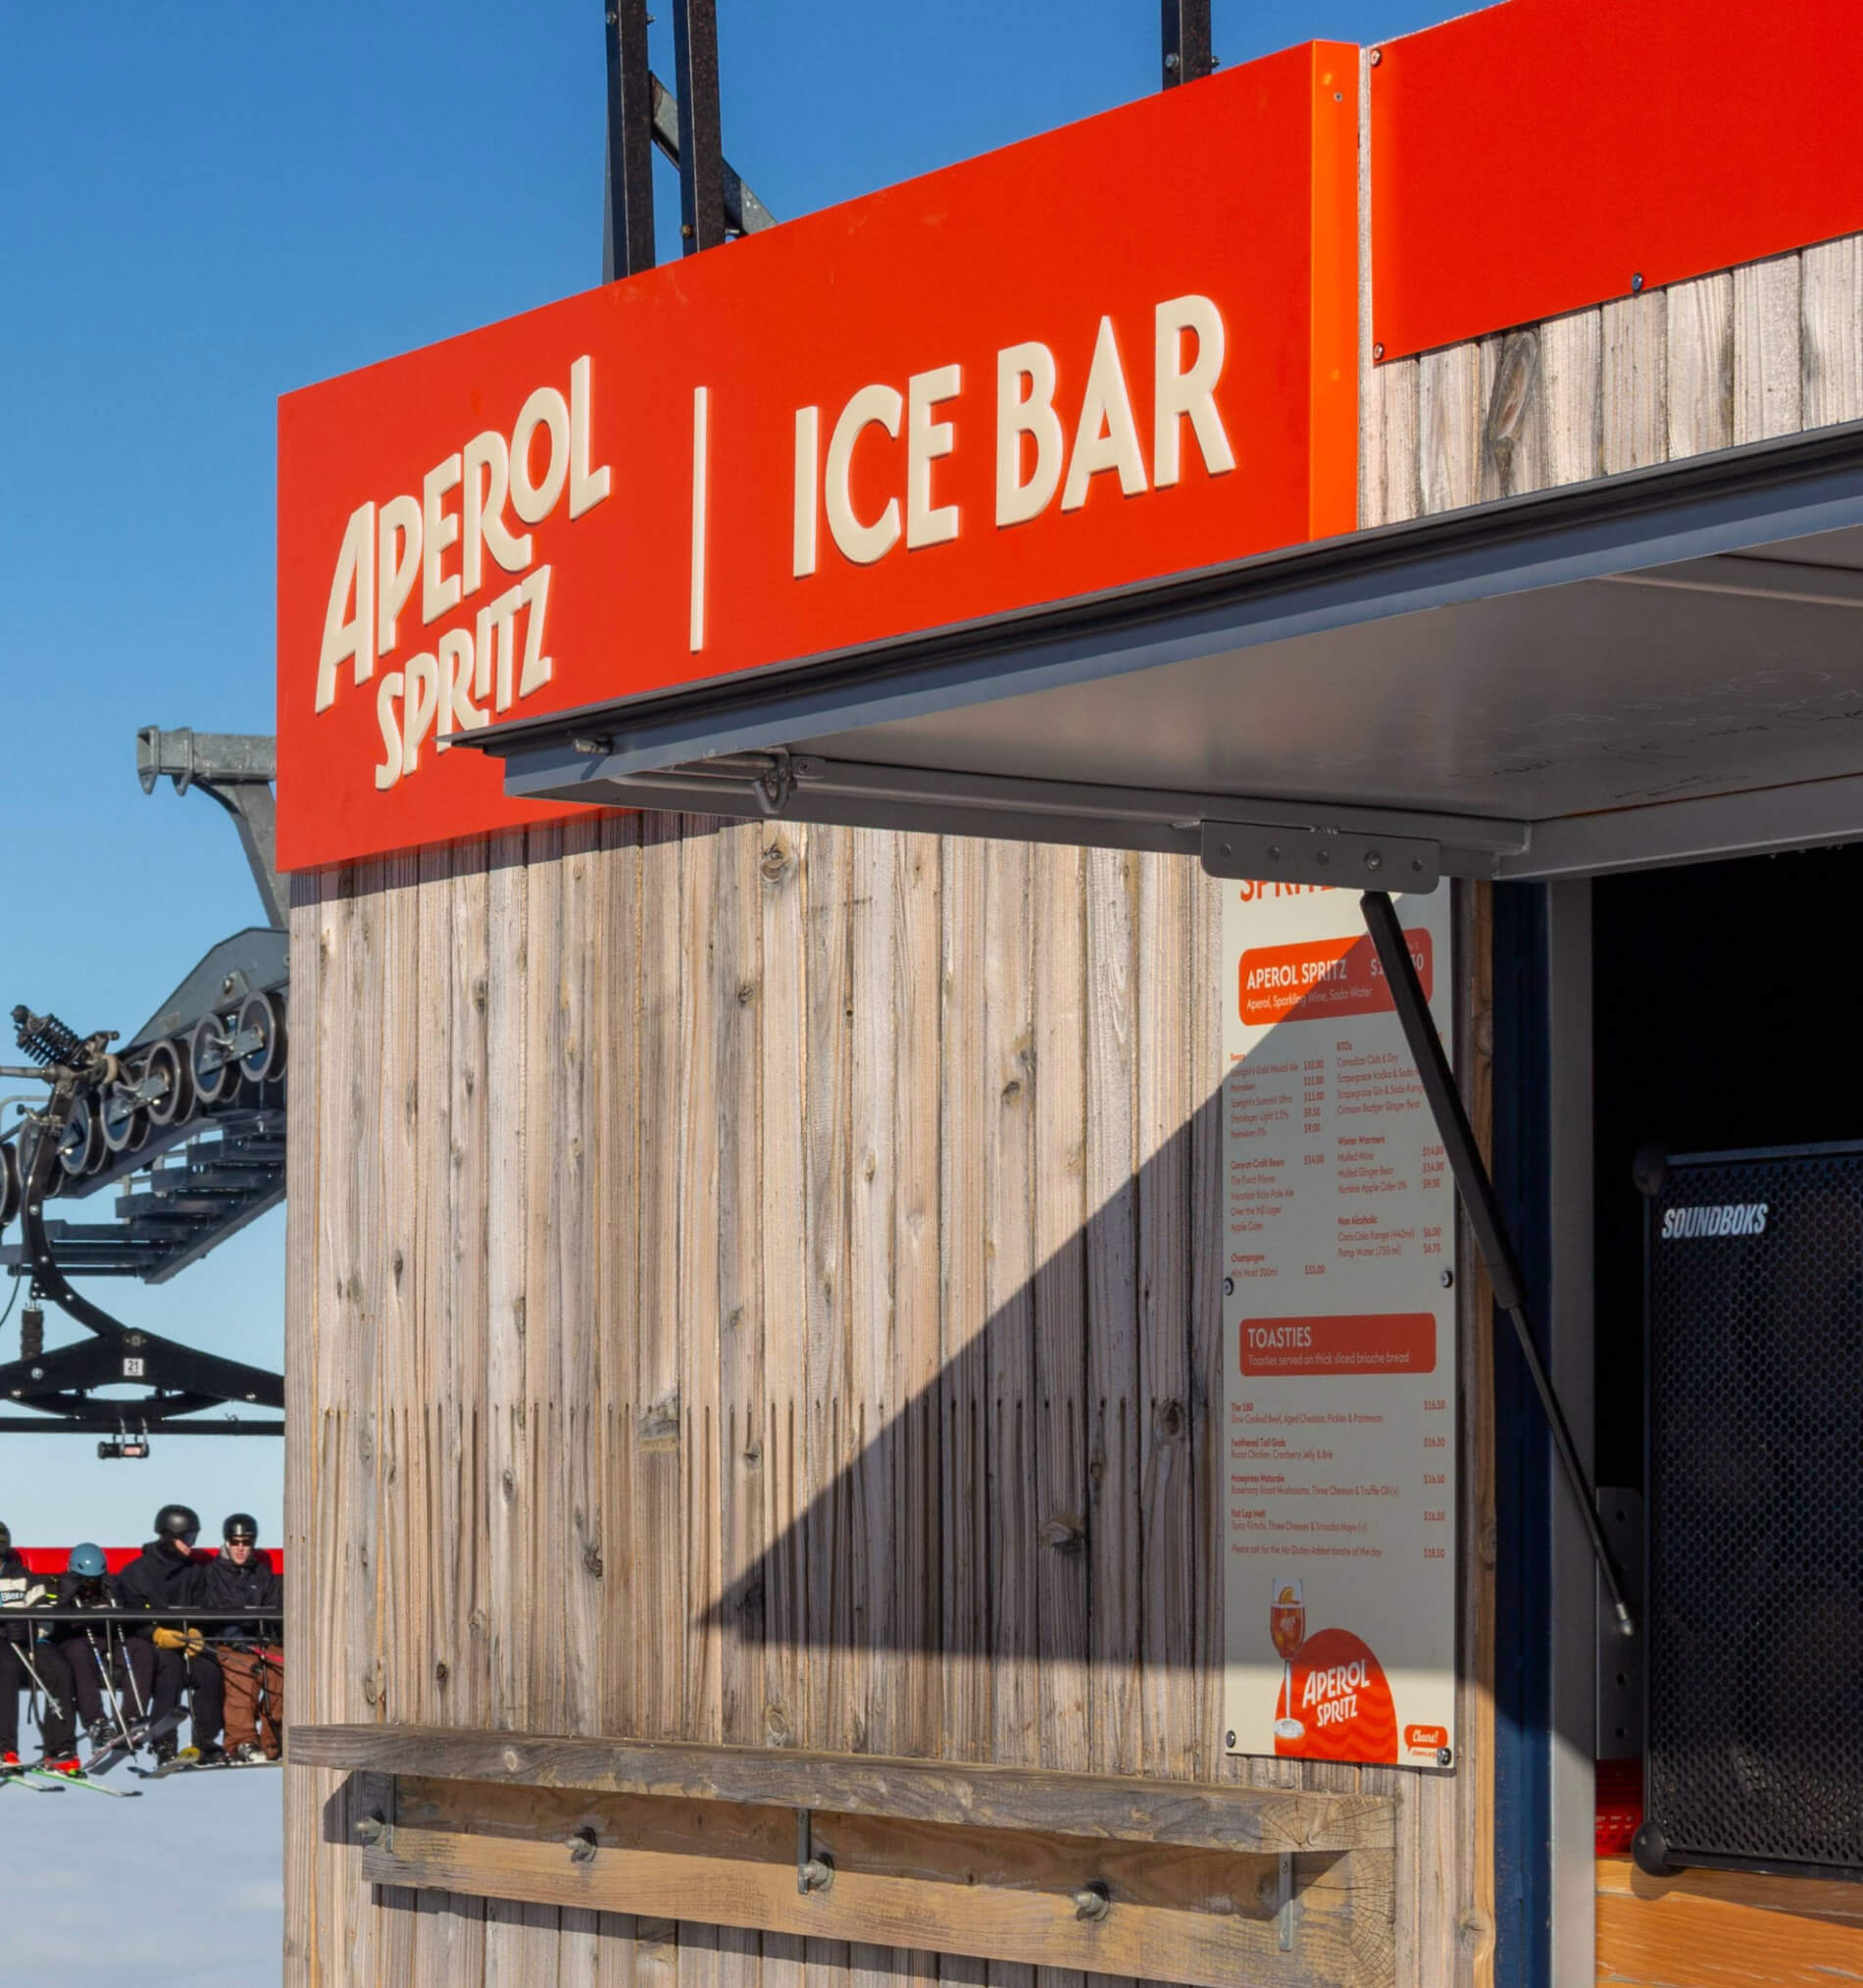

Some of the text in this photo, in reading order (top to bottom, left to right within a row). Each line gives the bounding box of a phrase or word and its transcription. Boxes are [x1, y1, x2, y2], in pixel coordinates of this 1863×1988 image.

[794, 294, 1235, 578] ICE BAR
[315, 354, 611, 714] APEROL
[375, 565, 553, 791] SPRITZ
[1247, 965, 1297, 990] APEROL
[1302, 959, 1346, 984] SPRITZ
[1247, 996, 1272, 1011] Aperol,
[1273, 993, 1306, 1009] Sparkling
[1330, 989, 1348, 1000] Soda
[1349, 987, 1373, 998] Water
[1304, 1123, 1321, 1134] $9.00
[1662, 1203, 1769, 1240] SOUNDBOKS
[1247, 1326, 1312, 1349] TOASTIES
[127, 1359, 139, 1372] 21
[1248, 1354, 1279, 1366] Toasties
[1279, 1353, 1302, 1365] served
[1315, 1351, 1334, 1364] thick
[1334, 1351, 1356, 1364] sliced
[1356, 1351, 1385, 1364] brioche
[1385, 1350, 1410, 1363] bread
[1302, 1659, 1371, 1708] APEROL
[1317, 1694, 1358, 1727] SPRITZ
[1412, 1729, 1438, 1744] Cheers!
